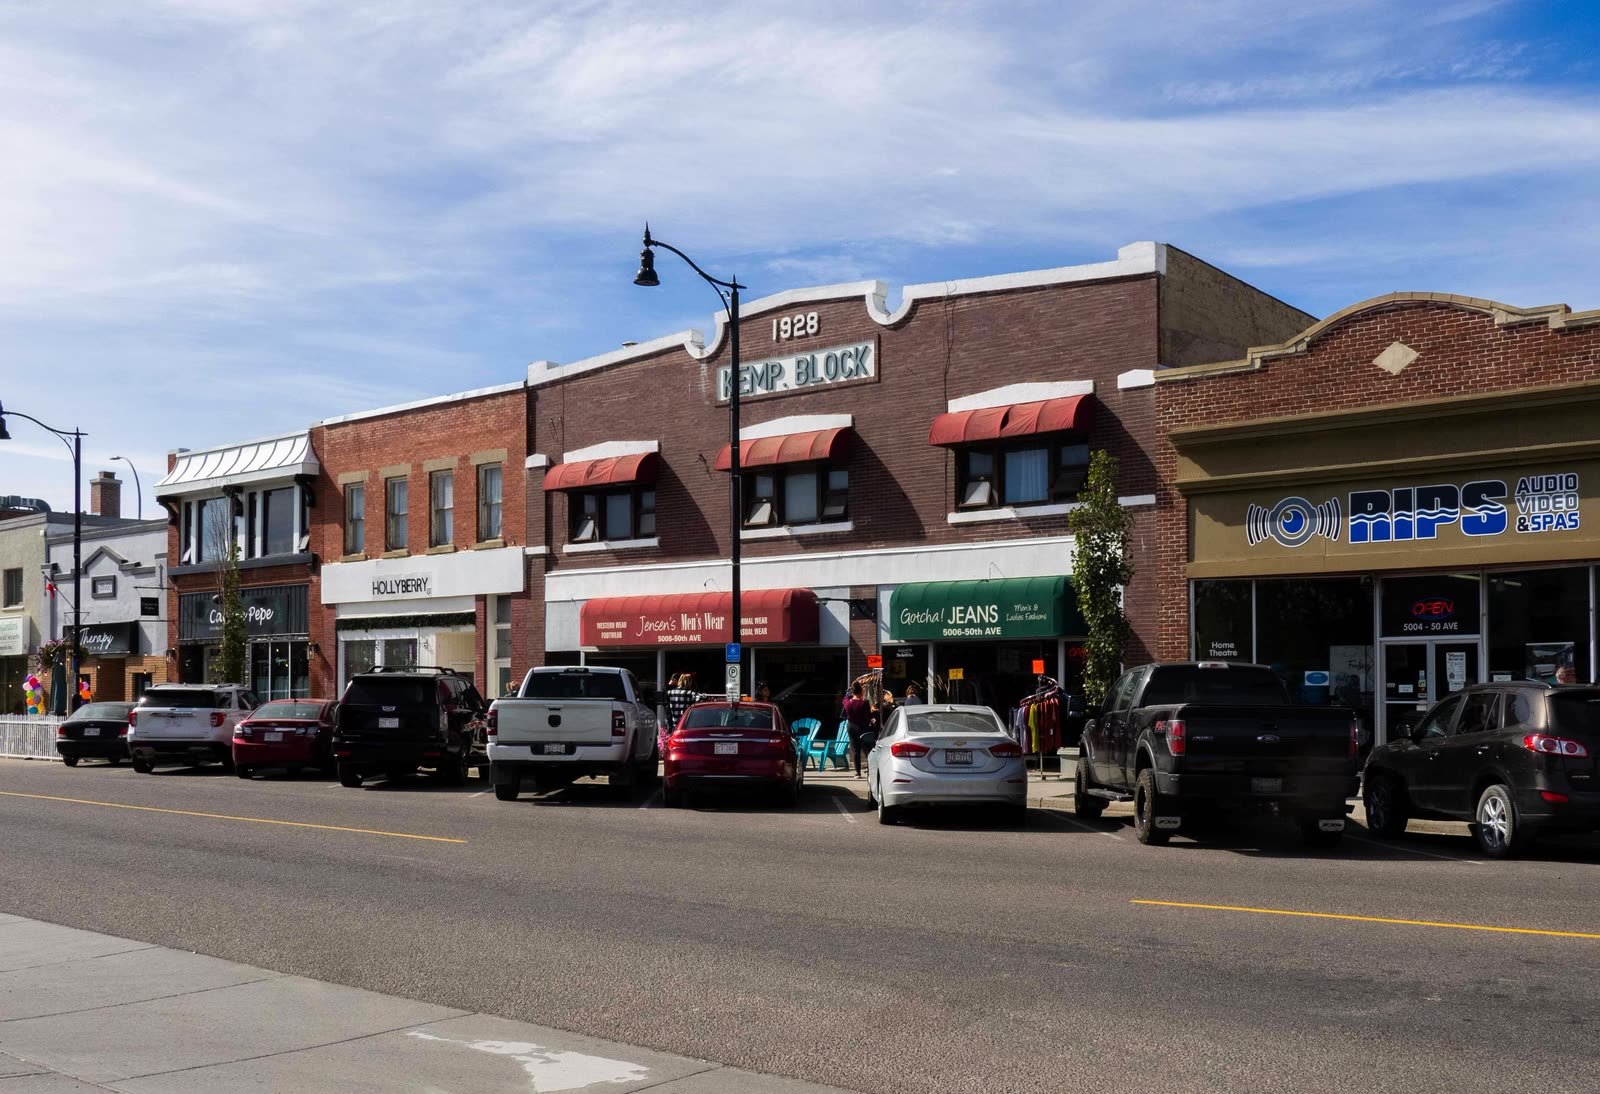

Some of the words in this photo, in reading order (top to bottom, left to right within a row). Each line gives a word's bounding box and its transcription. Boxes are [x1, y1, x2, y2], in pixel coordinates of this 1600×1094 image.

[772, 312, 818, 341] 1928
[795, 346, 871, 386] BLOCK
[1515, 473, 1578, 495] AUDIO
[1514, 492, 1579, 514] VIDEO
[1349, 481, 1507, 543] RIPS
[372, 577, 429, 595] HOLLYBERRY
[248, 606, 275, 626] Pepe
[900, 608, 945, 625] Gotcha!
[947, 604, 999, 625] JEANS
[1412, 601, 1455, 615] OPEN
[635, 615, 677, 637] Jensen's
[680, 613, 702, 631] Men's
[704, 612, 725, 630] Wear
[740, 617, 754, 625] RMAL
[754, 616, 768, 624] WEAR
[1005, 612, 1024, 622] Ladies
[1024, 612, 1048, 621] Fashions
[596, 622, 615, 630] WESTERN
[615, 621, 627, 629] WEAR
[740, 628, 754, 636] SUAL
[754, 627, 768, 635] WEAR
[942, 627, 983, 636] 5006-50th
[984, 627, 1002, 635] AVE
[1403, 623, 1423, 631] 5004
[1430, 623, 1441, 631] 50
[1443, 622, 1459, 630] AVE
[79, 628, 115, 650] Therapy
[601, 631, 622, 639] FOOTWEAR
[1209, 649, 1238, 657] Theatre
[1211, 641, 1235, 649] Home
